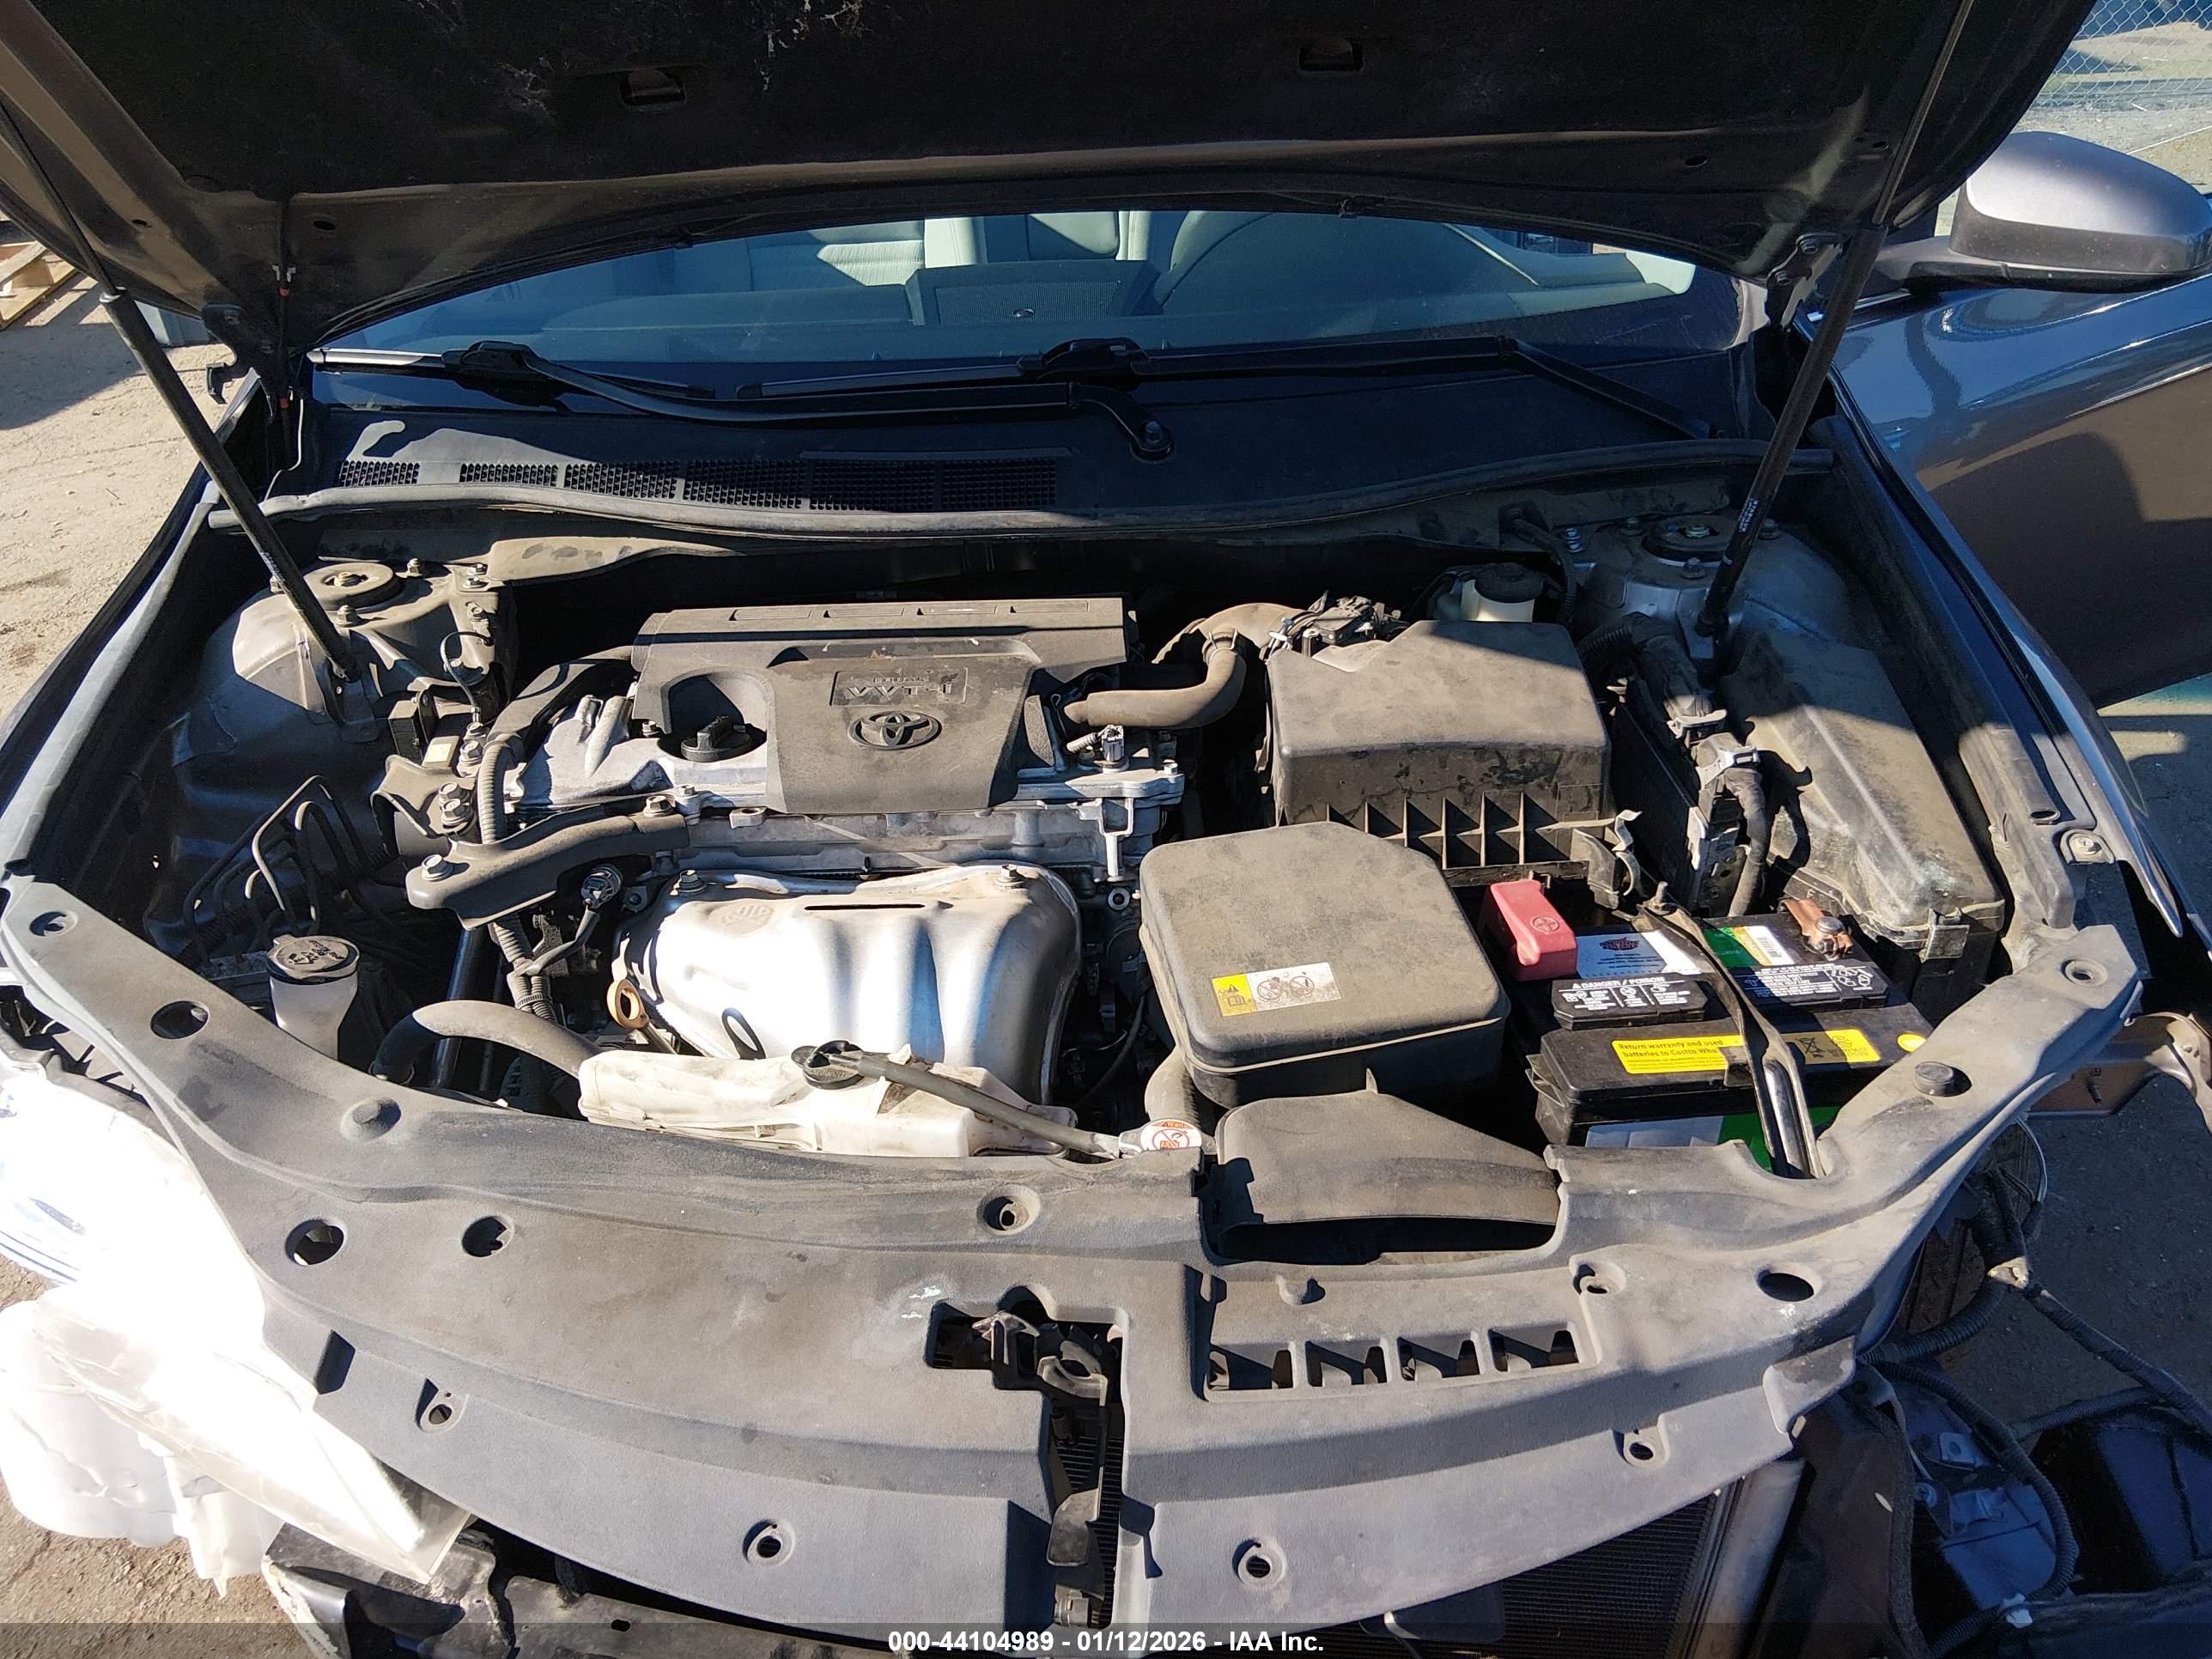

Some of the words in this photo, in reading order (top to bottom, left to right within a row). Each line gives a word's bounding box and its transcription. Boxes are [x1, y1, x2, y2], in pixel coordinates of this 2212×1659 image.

[1582, 980, 1620, 989] DANGER
[1629, 976, 1666, 985] POISON
[1648, 1041, 1686, 1049] warranty
[1670, 1048, 1698, 1056] Costco
